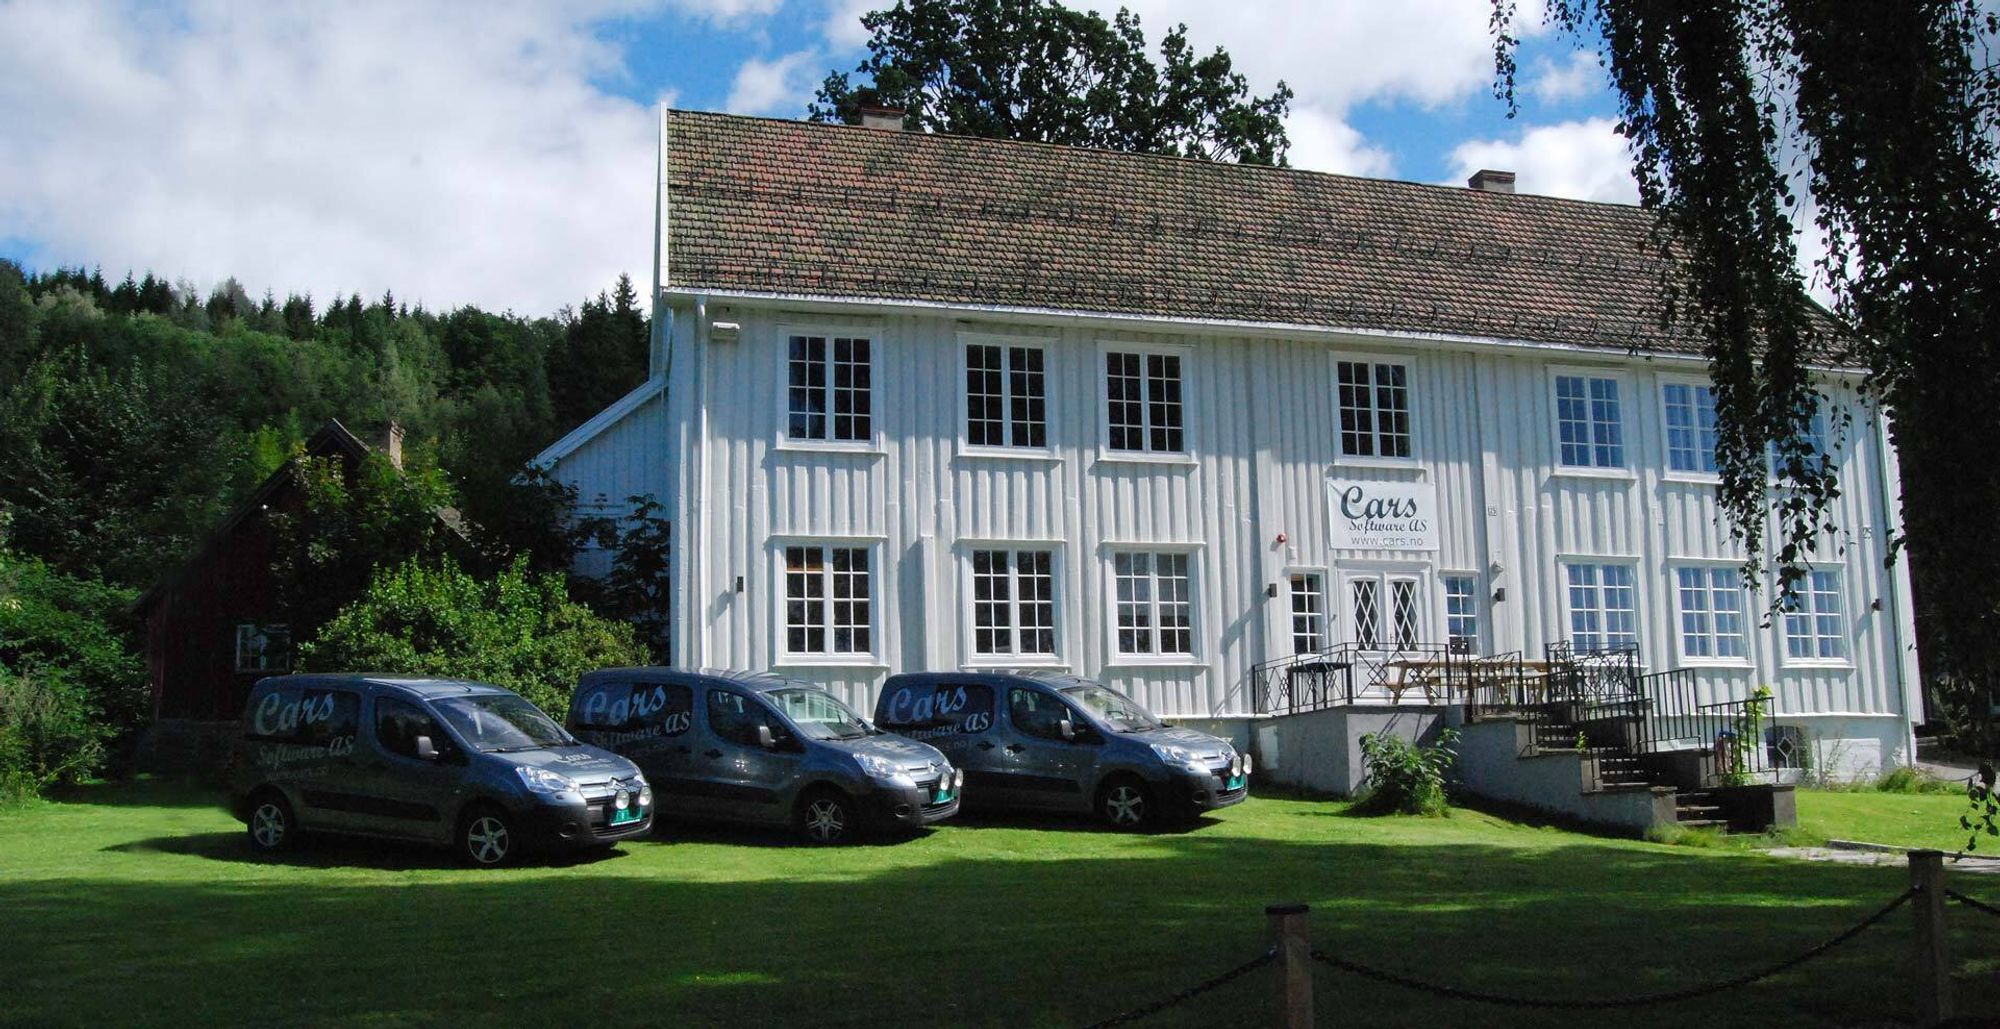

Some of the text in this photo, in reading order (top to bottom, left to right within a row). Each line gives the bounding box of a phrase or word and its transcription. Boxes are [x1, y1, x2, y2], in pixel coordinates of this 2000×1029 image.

[1340, 486, 1417, 520] Cars
[1349, 519, 1427, 535] Software AS
[1351, 536, 1424, 546] www.cars.no
[255, 692, 334, 735] Cars
[584, 685, 666, 727] Cars
[889, 686, 967, 724] Cars
